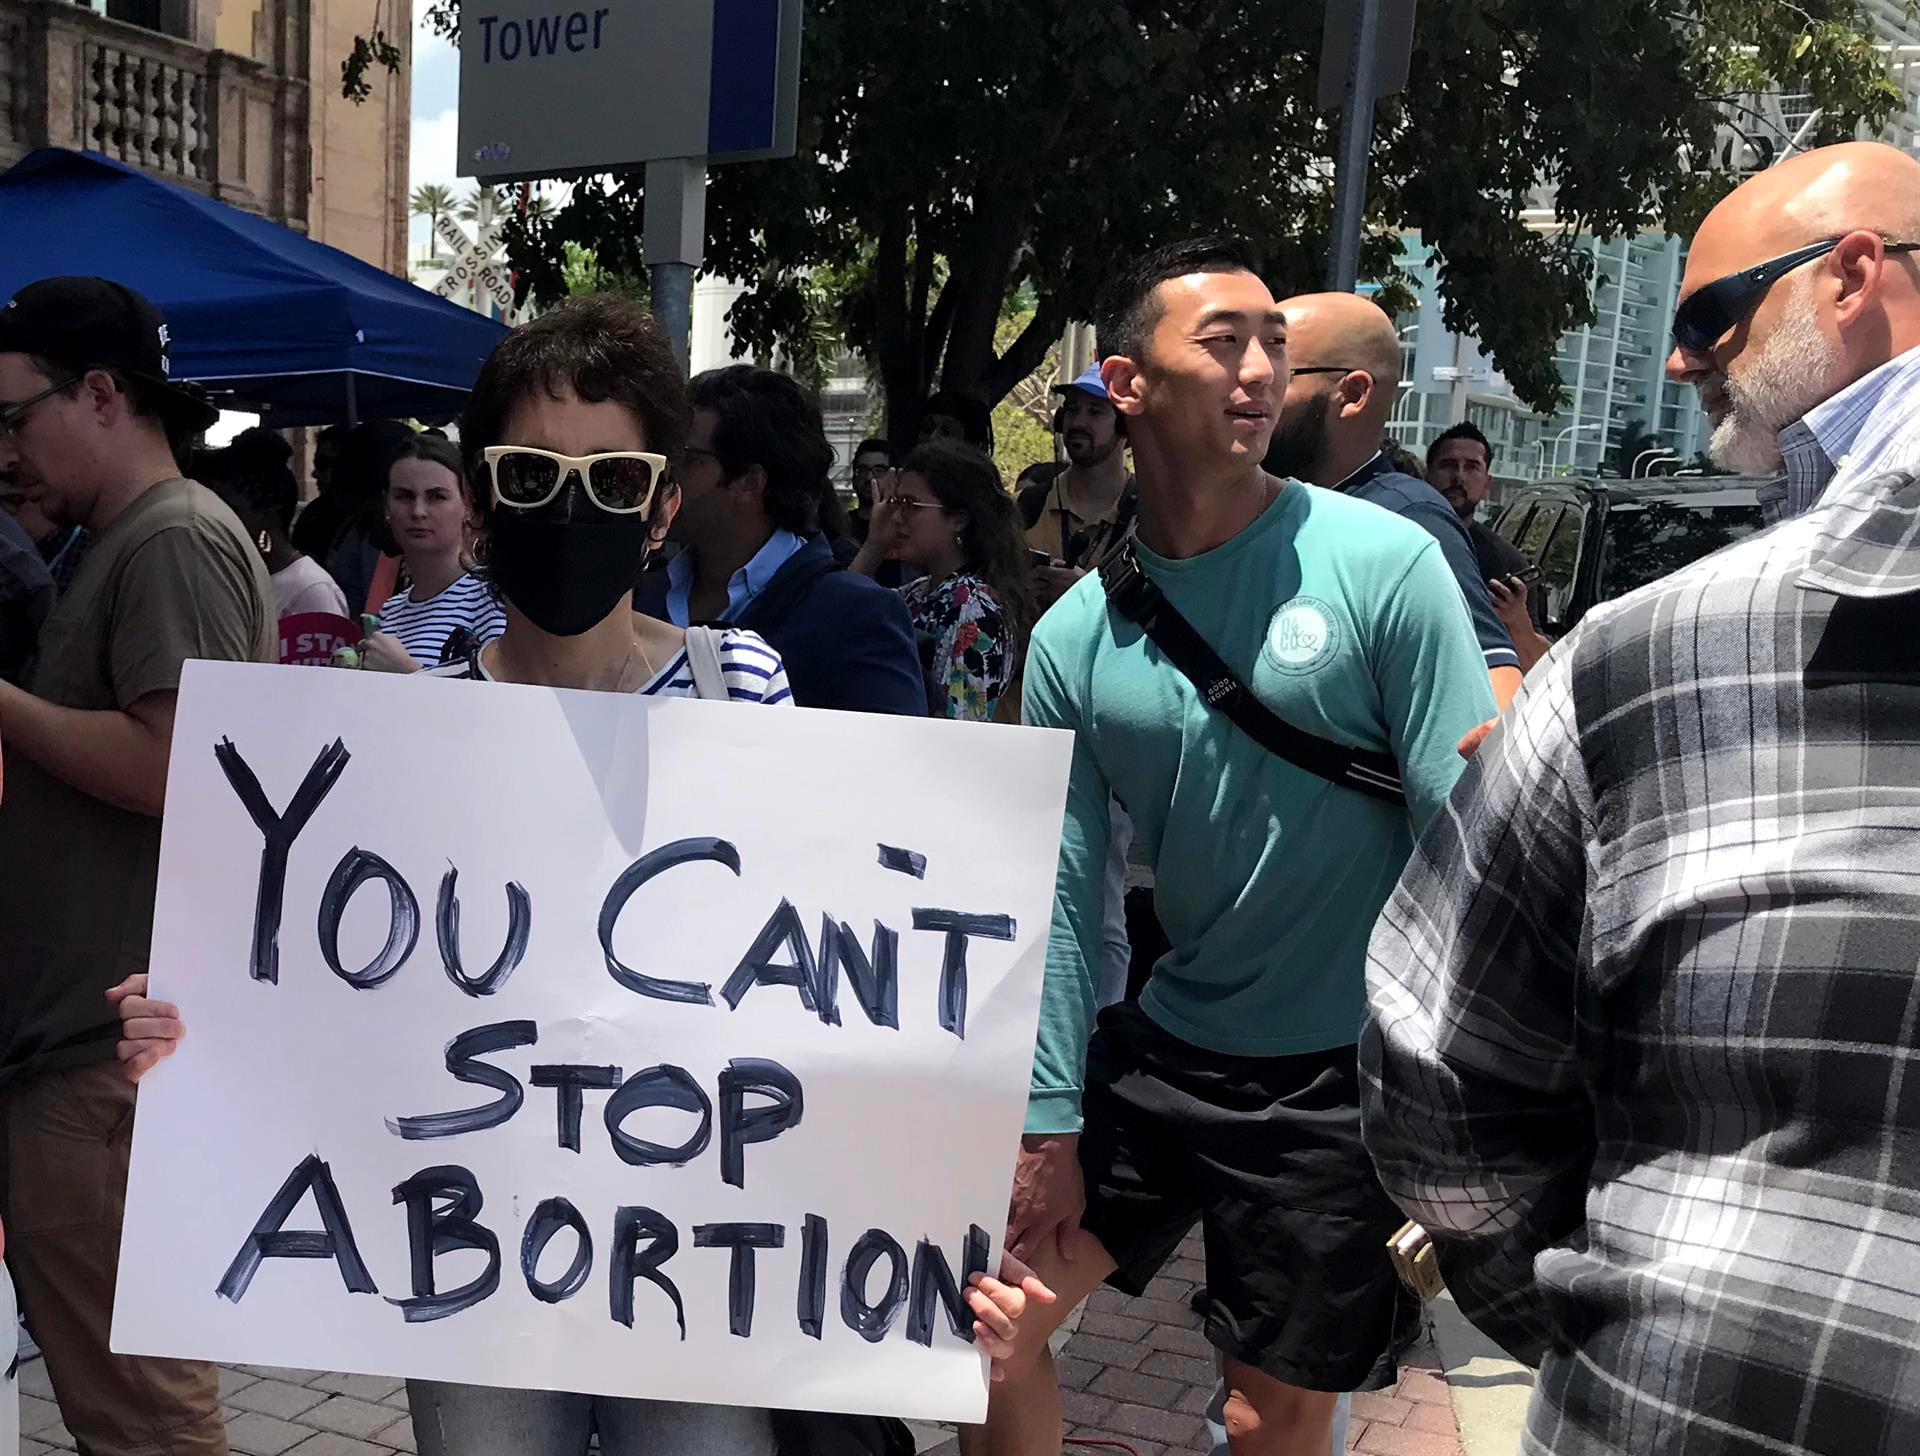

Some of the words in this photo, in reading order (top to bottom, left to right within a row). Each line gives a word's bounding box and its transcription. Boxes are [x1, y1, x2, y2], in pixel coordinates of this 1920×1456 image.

[478, 8, 609, 63] Tower
[436, 231, 504, 298] CROSSIN
[437, 217, 467, 254] RAIL
[478, 267, 511, 304] ROAD
[1207, 681, 1237, 704] TROUBLE
[1208, 678, 1229, 695] GOOD
[214, 735, 532, 998] YOU
[597, 836, 1017, 1040] CAN'T
[384, 1020, 804, 1189] STOP
[215, 1150, 990, 1345] ABORTION
